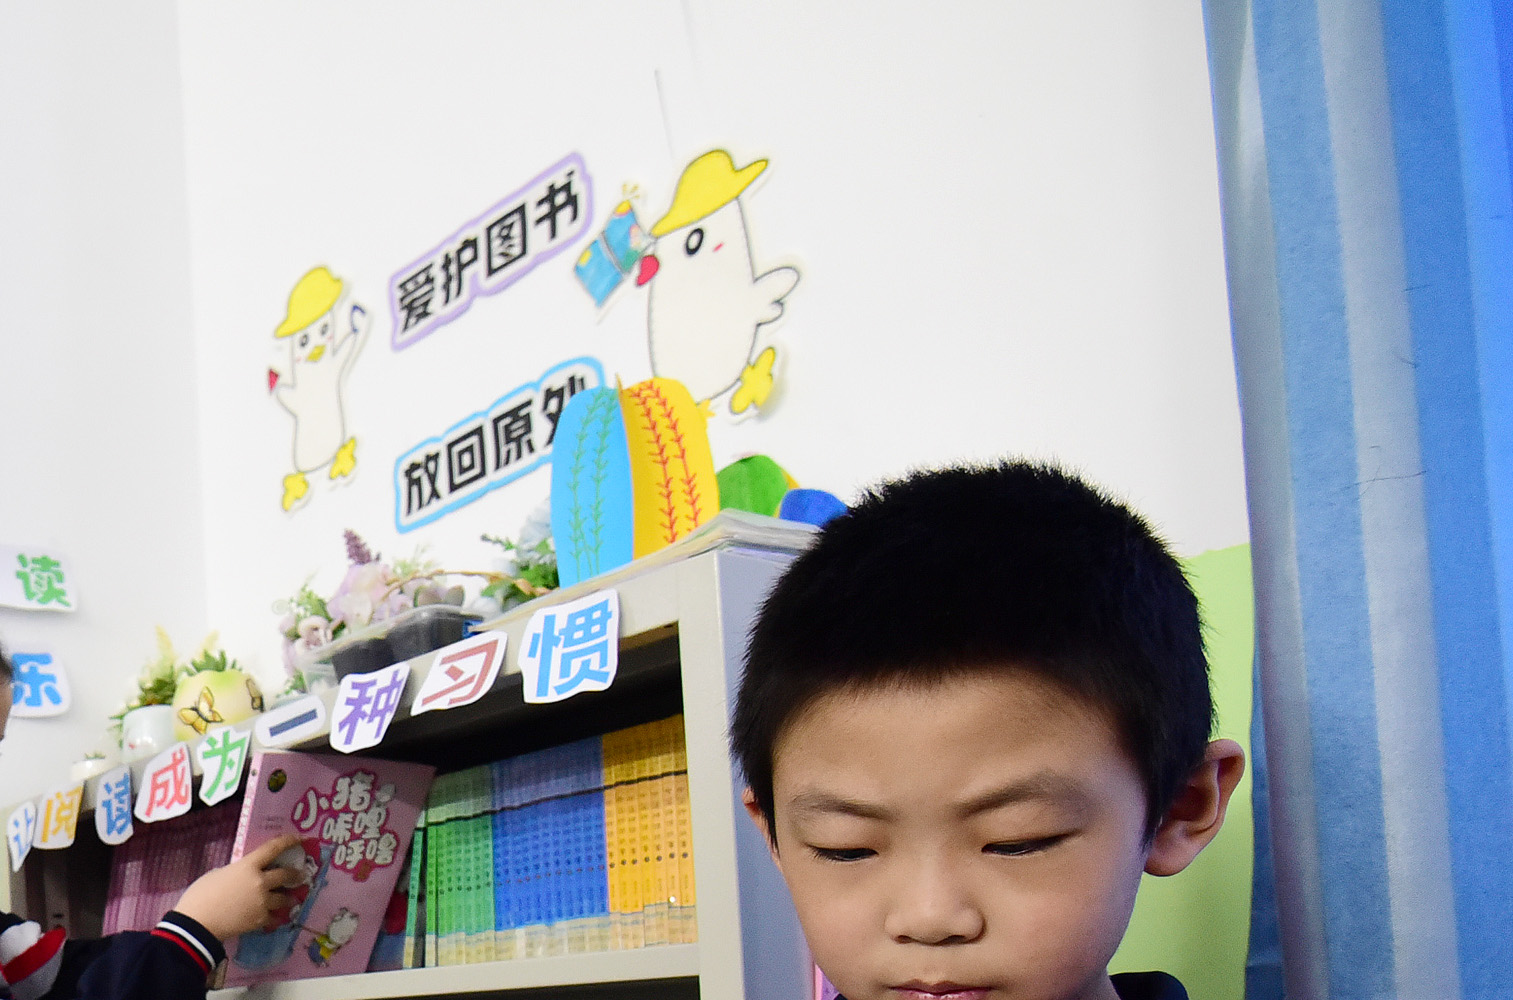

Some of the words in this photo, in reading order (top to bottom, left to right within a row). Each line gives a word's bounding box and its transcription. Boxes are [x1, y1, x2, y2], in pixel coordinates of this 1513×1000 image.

[398, 170, 579, 334] 爱护图书
[12, 597, 615, 858] 让阅读成为一种习惯
[292, 769, 377, 831] 小猪
